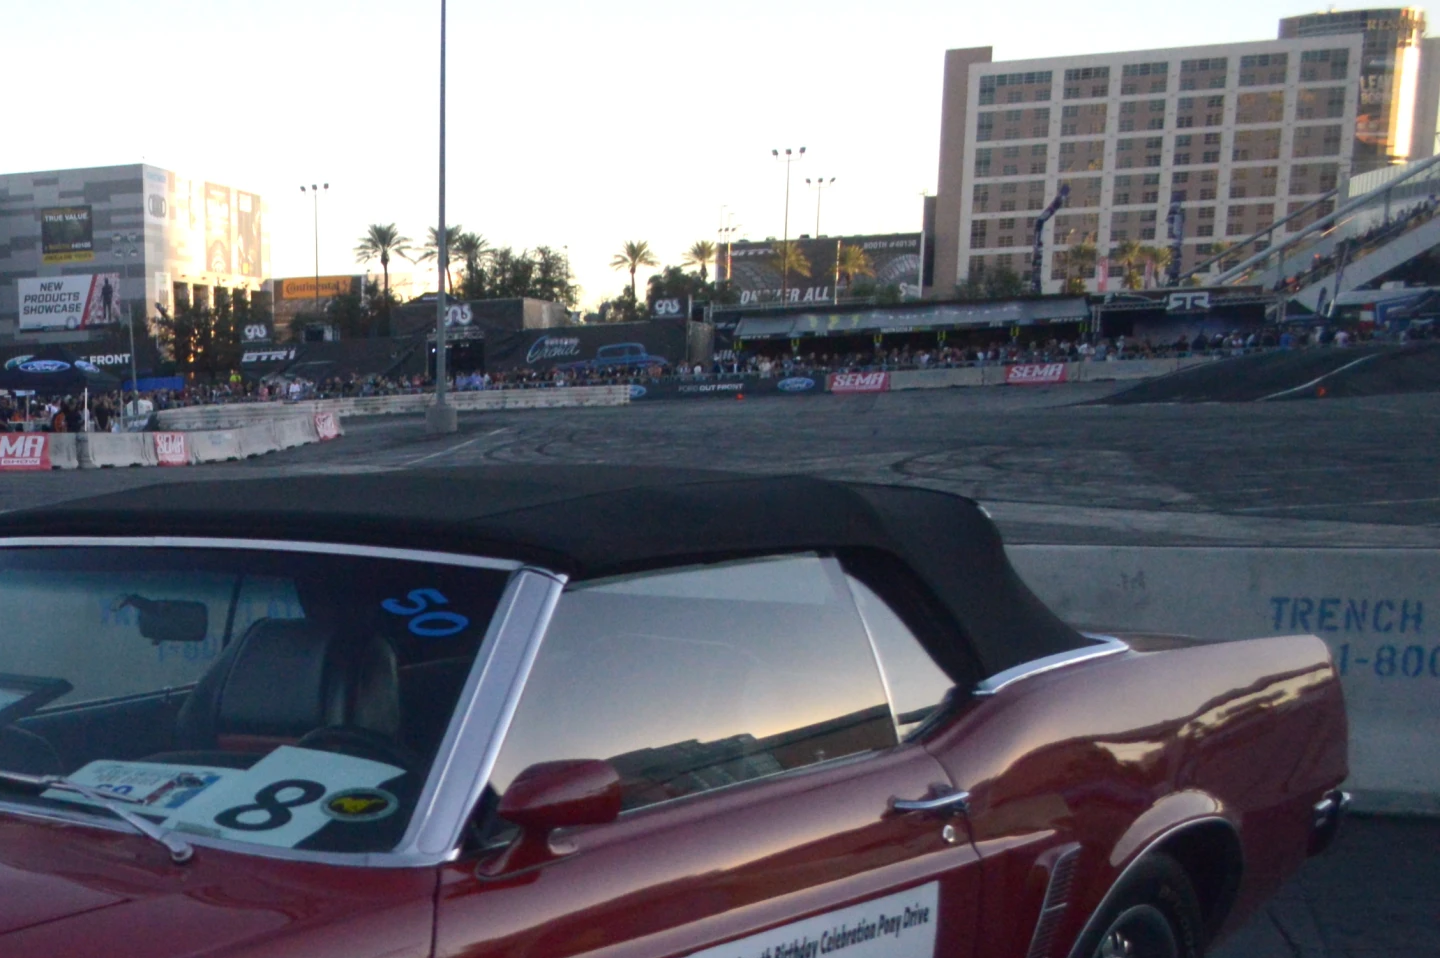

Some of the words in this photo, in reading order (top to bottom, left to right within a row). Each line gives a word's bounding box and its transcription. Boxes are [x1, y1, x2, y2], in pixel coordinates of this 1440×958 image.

[45, 214, 63, 222] TRUE
[40, 282, 63, 292] NEW
[286, 281, 340, 294] Continental
[24, 292, 80, 303] PRODUCTS
[23, 303, 82, 315] SHOWCASE
[90, 353, 131, 366] FRONT
[1010, 364, 1064, 380] SEMA
[832, 372, 885, 388] SEMA
[717, 383, 744, 391] FRONT
[157, 433, 185, 454] SEMA
[2, 458, 40, 466] SHOW
[382, 588, 470, 636] 50
[1270, 596, 1423, 634] TRENCH
[213, 779, 327, 832] 8
[820, 917, 876, 955] Celebration
[877, 913, 902, 938] Pony
[903, 902, 930, 929] Drive
